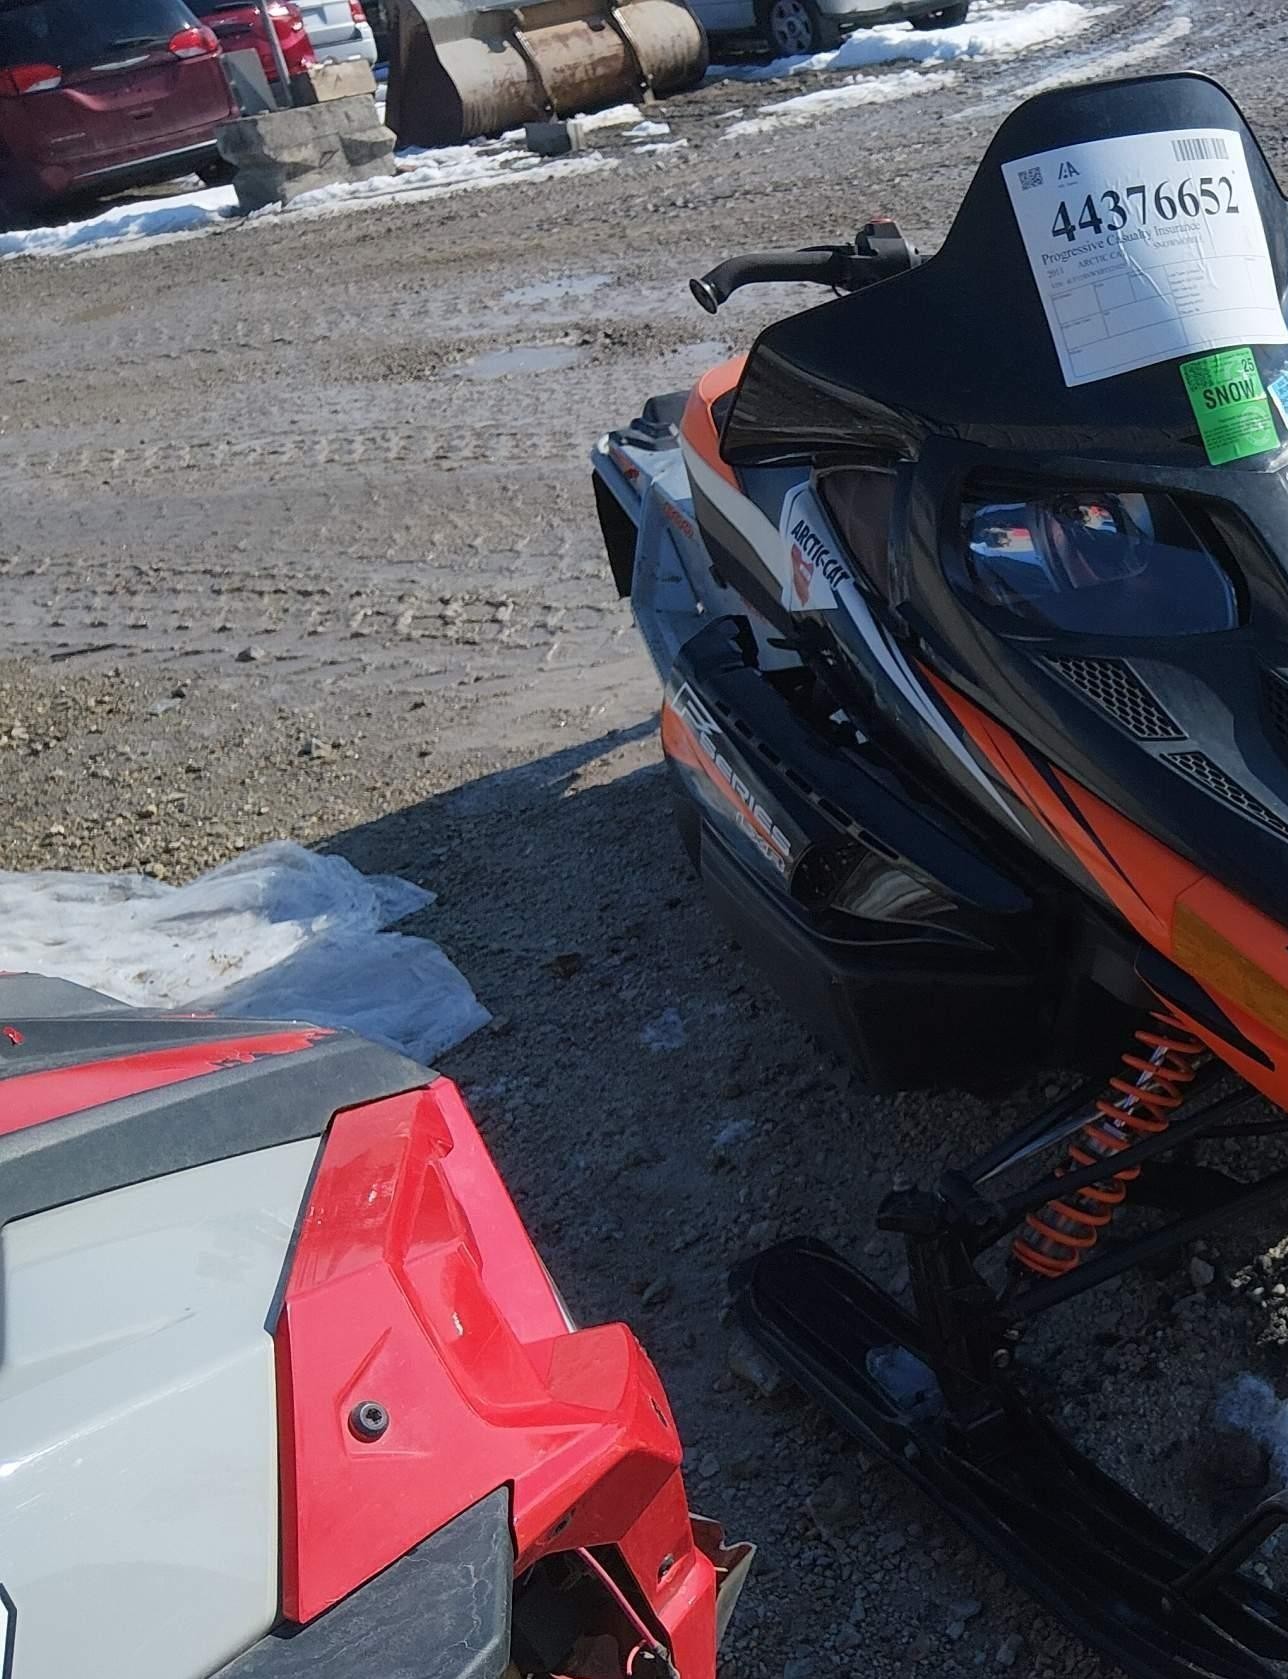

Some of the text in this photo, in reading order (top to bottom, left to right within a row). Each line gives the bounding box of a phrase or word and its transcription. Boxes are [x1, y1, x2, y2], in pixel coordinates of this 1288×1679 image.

[1051, 176, 1240, 242] 44376652
[1041, 221, 1200, 266] Progressive Casualty Insurance
[1241, 358, 1255, 373] 25
[1203, 379, 1256, 410] SNOW
